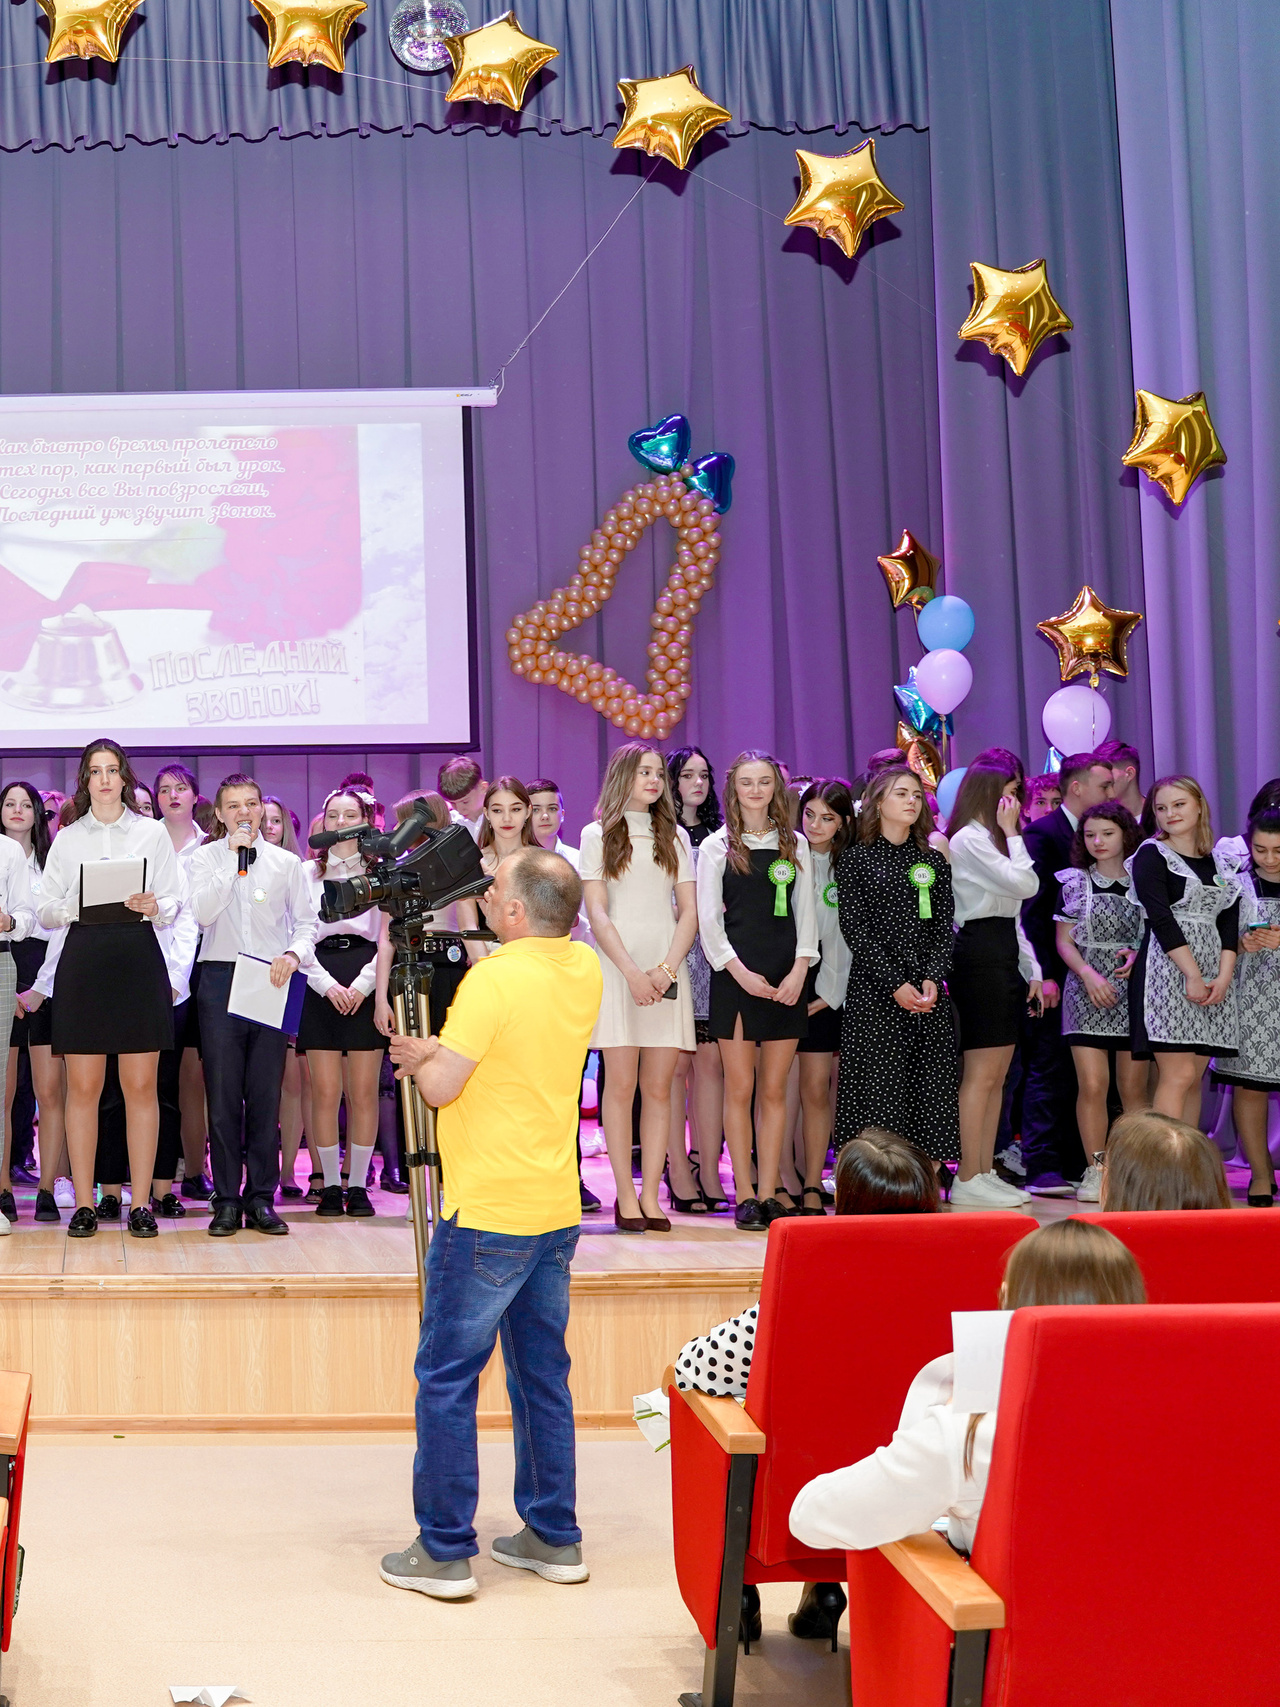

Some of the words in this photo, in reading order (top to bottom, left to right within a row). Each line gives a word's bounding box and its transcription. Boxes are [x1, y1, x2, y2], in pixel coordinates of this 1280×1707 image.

[32, 438, 104, 459] быстро
[109, 436, 168, 458] время
[173, 438, 278, 457] пролетело
[41, 463, 78, 482] пор,
[84, 462, 117, 475] как
[122, 458, 191, 480] первый
[196, 458, 232, 472] был
[236, 460, 286, 479] урок.
[0, 484, 72, 506] Сегодня
[78, 482, 108, 498] все
[114, 481, 142, 497] Вы
[147, 481, 269, 502] повзрослели,
[100, 507, 132, 526] уж
[133, 504, 205, 526] звучит
[207, 502, 276, 524] звонок.
[149, 638, 349, 691] ПОСЛЕДНИЙ
[186, 678, 322, 725] ЗВОНОК!
